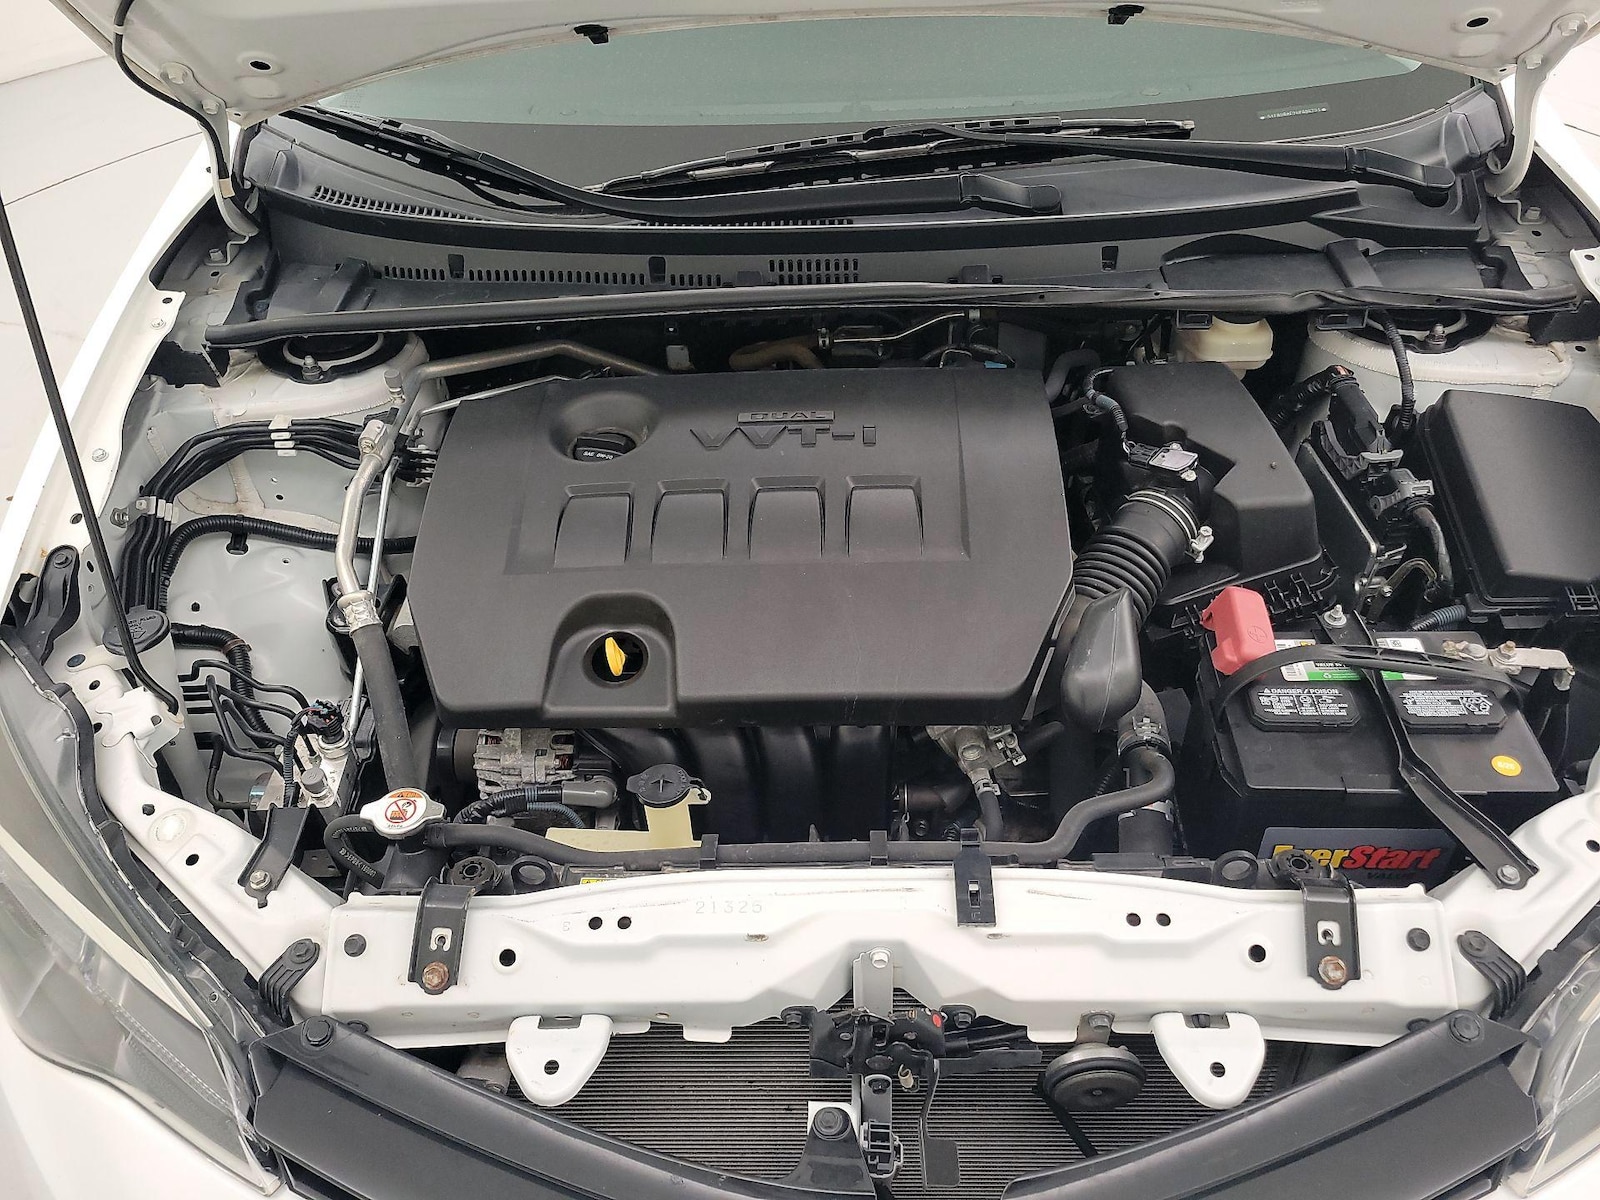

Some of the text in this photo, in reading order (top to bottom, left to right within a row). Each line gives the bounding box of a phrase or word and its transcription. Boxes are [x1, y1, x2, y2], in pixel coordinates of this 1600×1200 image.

[750, 411, 826, 419] DUAL
[689, 424, 877, 449] VVT-i
[1272, 845, 1441, 870] erStart
